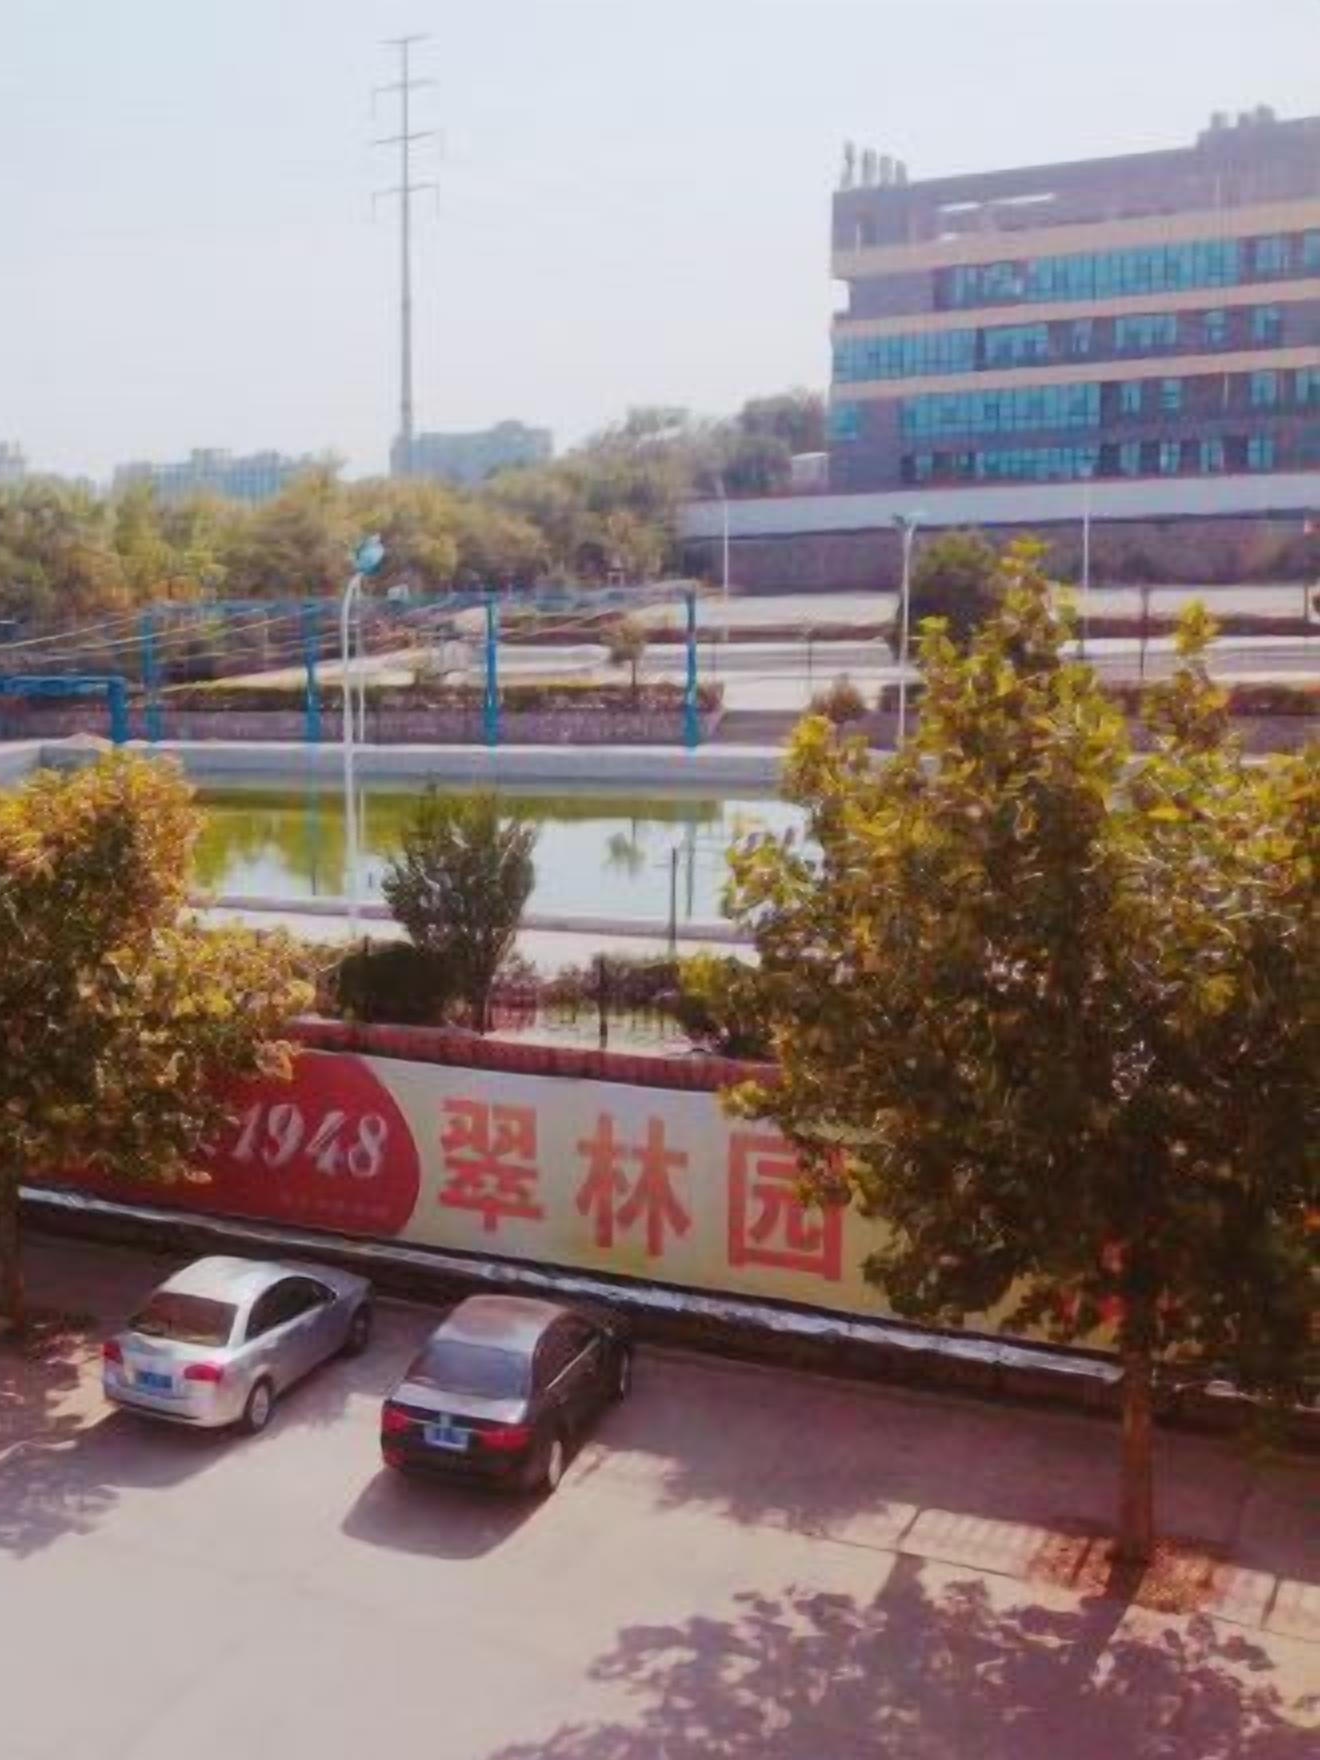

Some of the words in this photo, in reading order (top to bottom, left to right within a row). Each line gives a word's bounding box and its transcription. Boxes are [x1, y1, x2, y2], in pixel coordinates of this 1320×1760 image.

[233, 1101, 389, 1179] 1948
[439, 1096, 844, 1281] 翠林园
